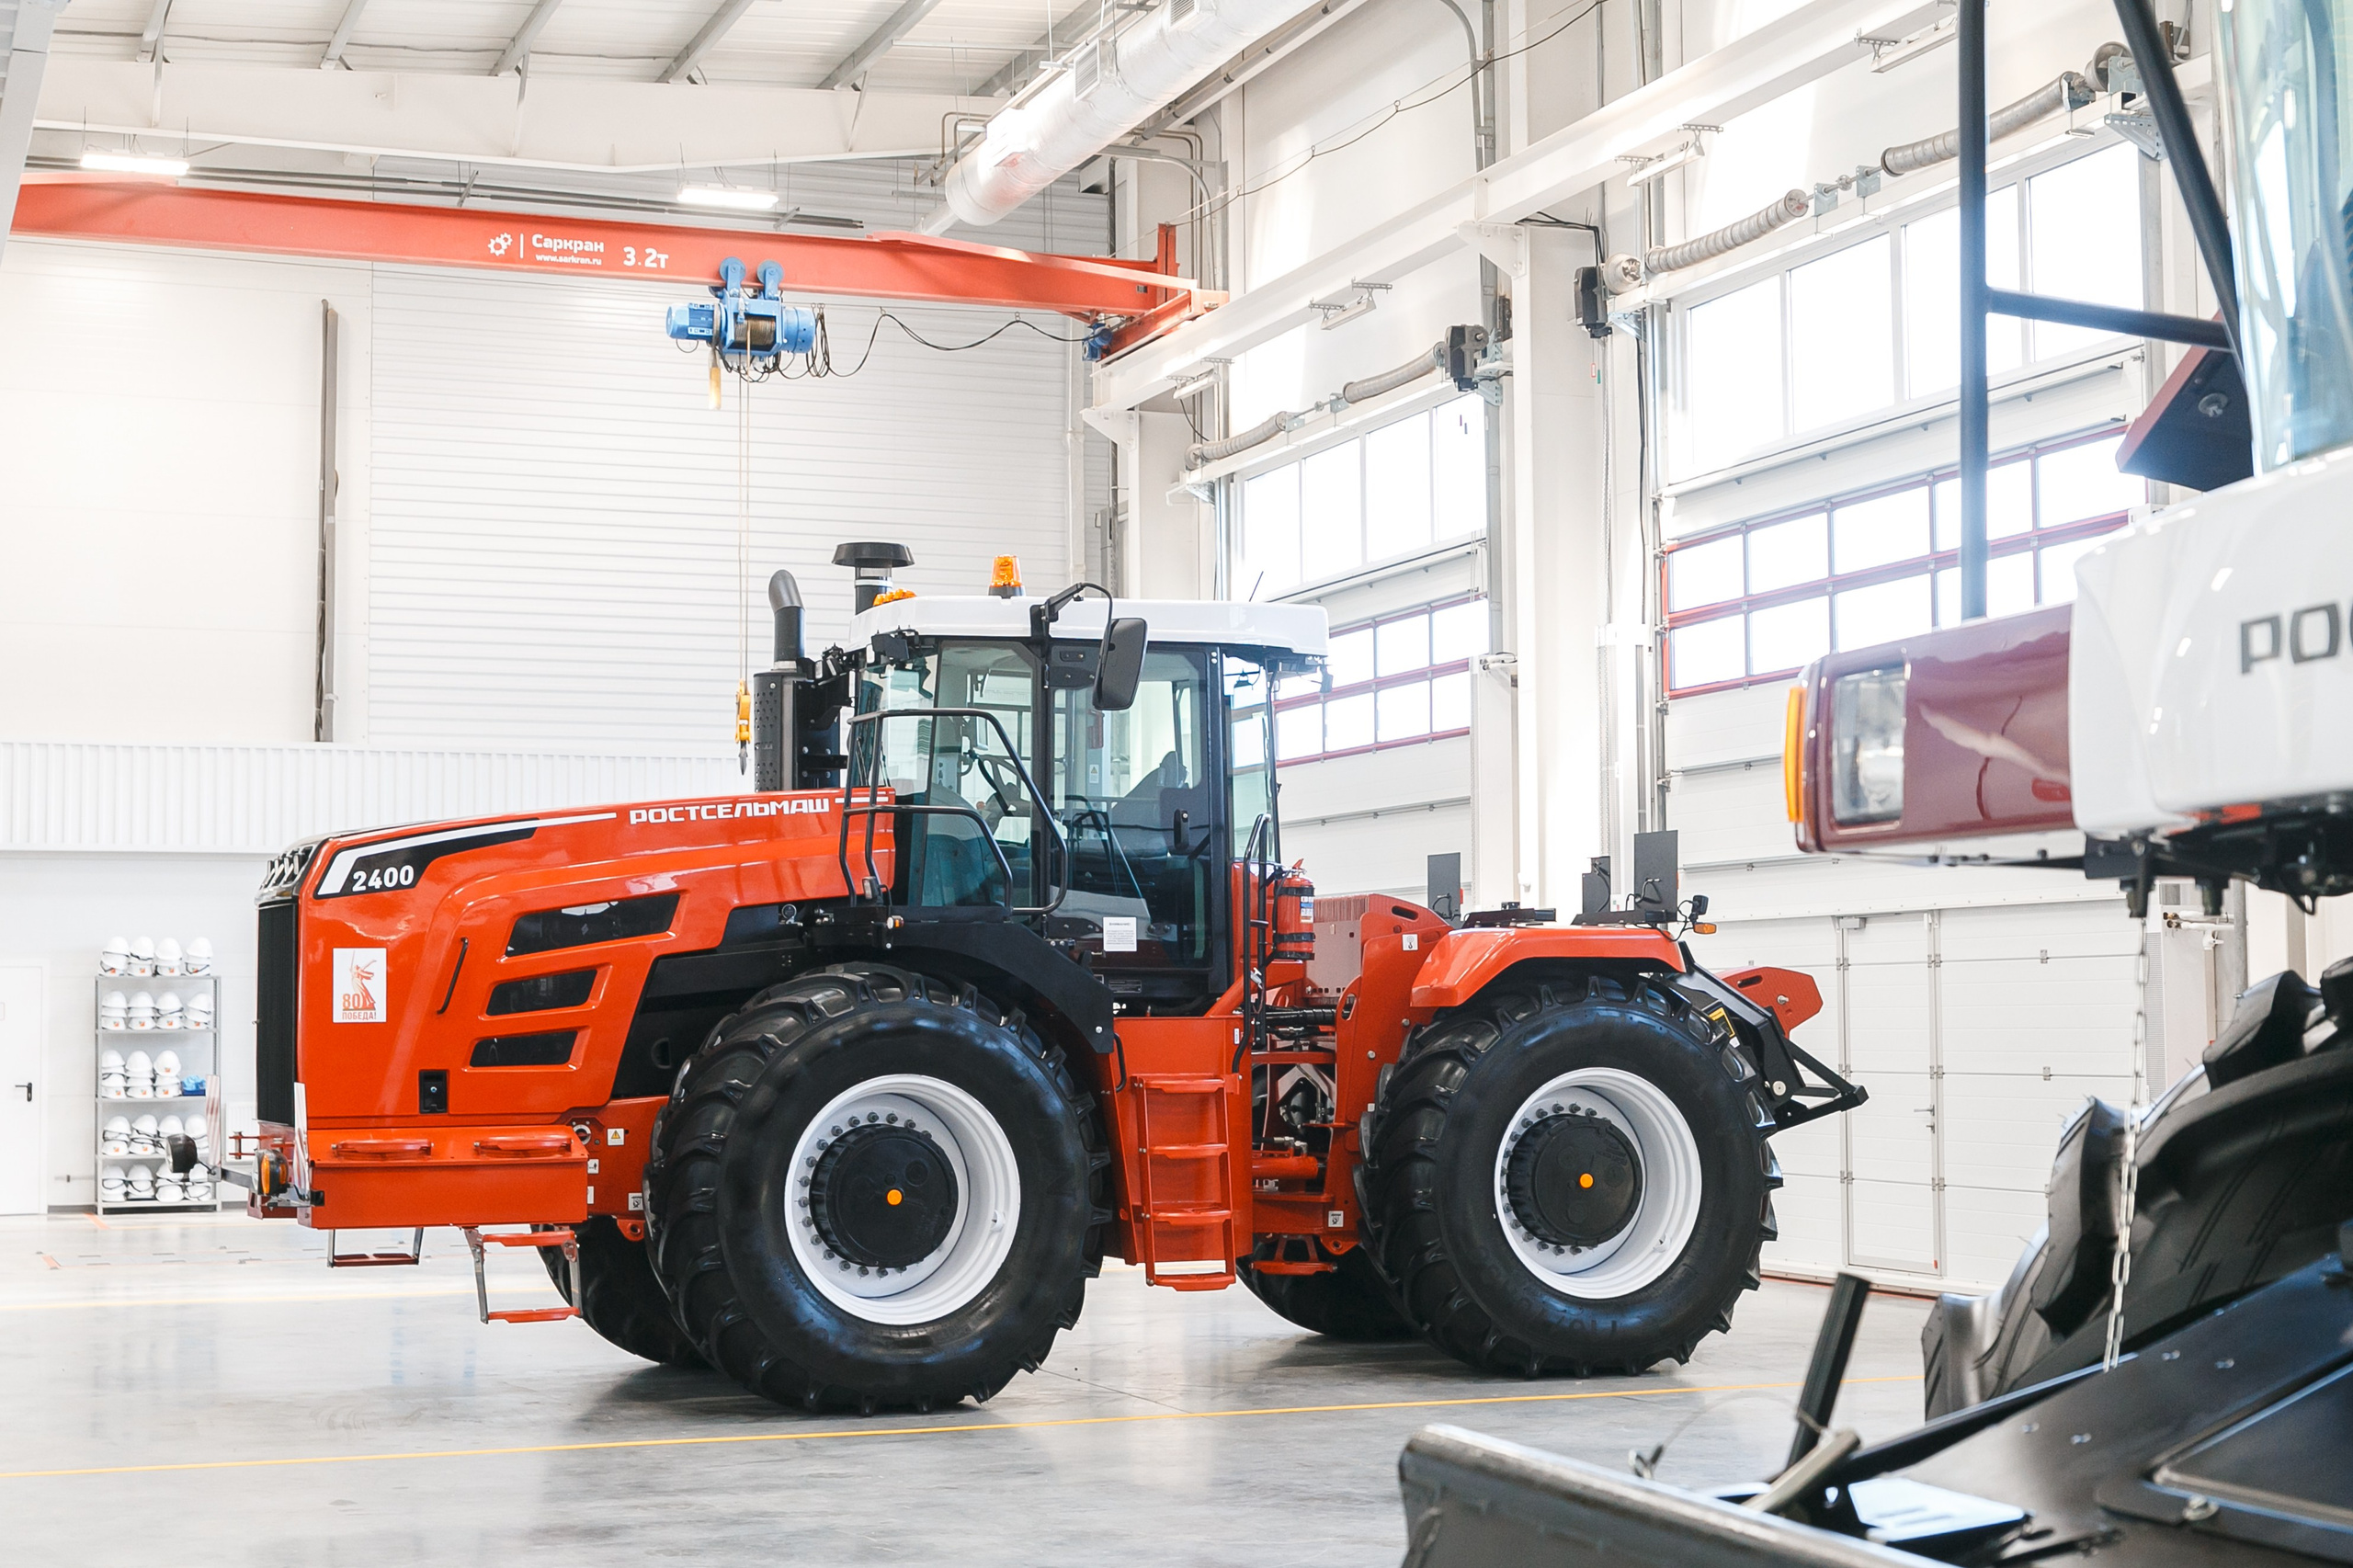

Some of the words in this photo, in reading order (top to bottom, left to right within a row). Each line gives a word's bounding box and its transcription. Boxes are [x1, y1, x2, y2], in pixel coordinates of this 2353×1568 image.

[531, 233, 605, 254] Саркран
[535, 254, 602, 266] www.sarkran.ru
[622, 246, 669, 268] 3.2т
[2240, 597, 2353, 675] РО
[630, 798, 830, 824] РОСТСЕЛЬМАШ
[352, 865, 415, 892] 2400
[342, 994, 361, 1010] 80
[342, 1012, 377, 1021] ПОБЕДА!
